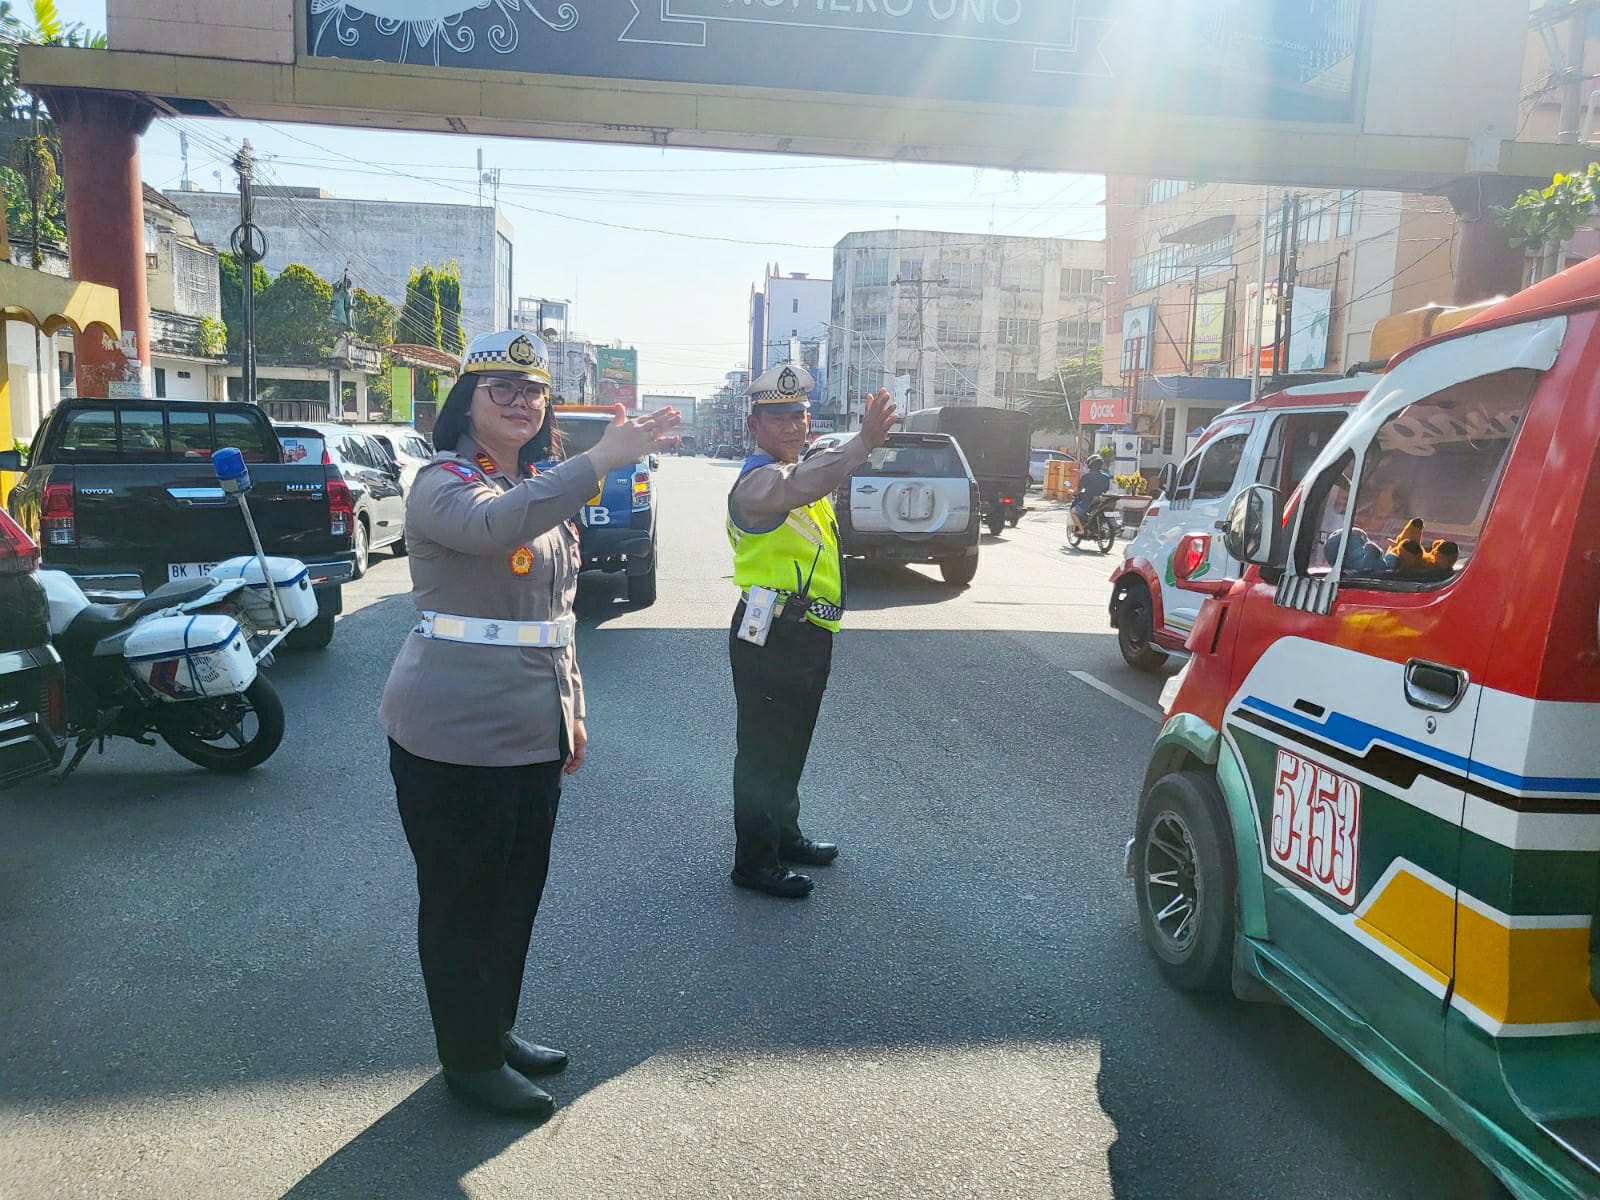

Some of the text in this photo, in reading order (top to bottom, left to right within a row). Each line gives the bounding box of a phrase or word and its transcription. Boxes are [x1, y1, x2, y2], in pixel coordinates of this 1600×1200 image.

[171, 563, 219, 578] BK 15
[1273, 752, 1358, 896] 5453
